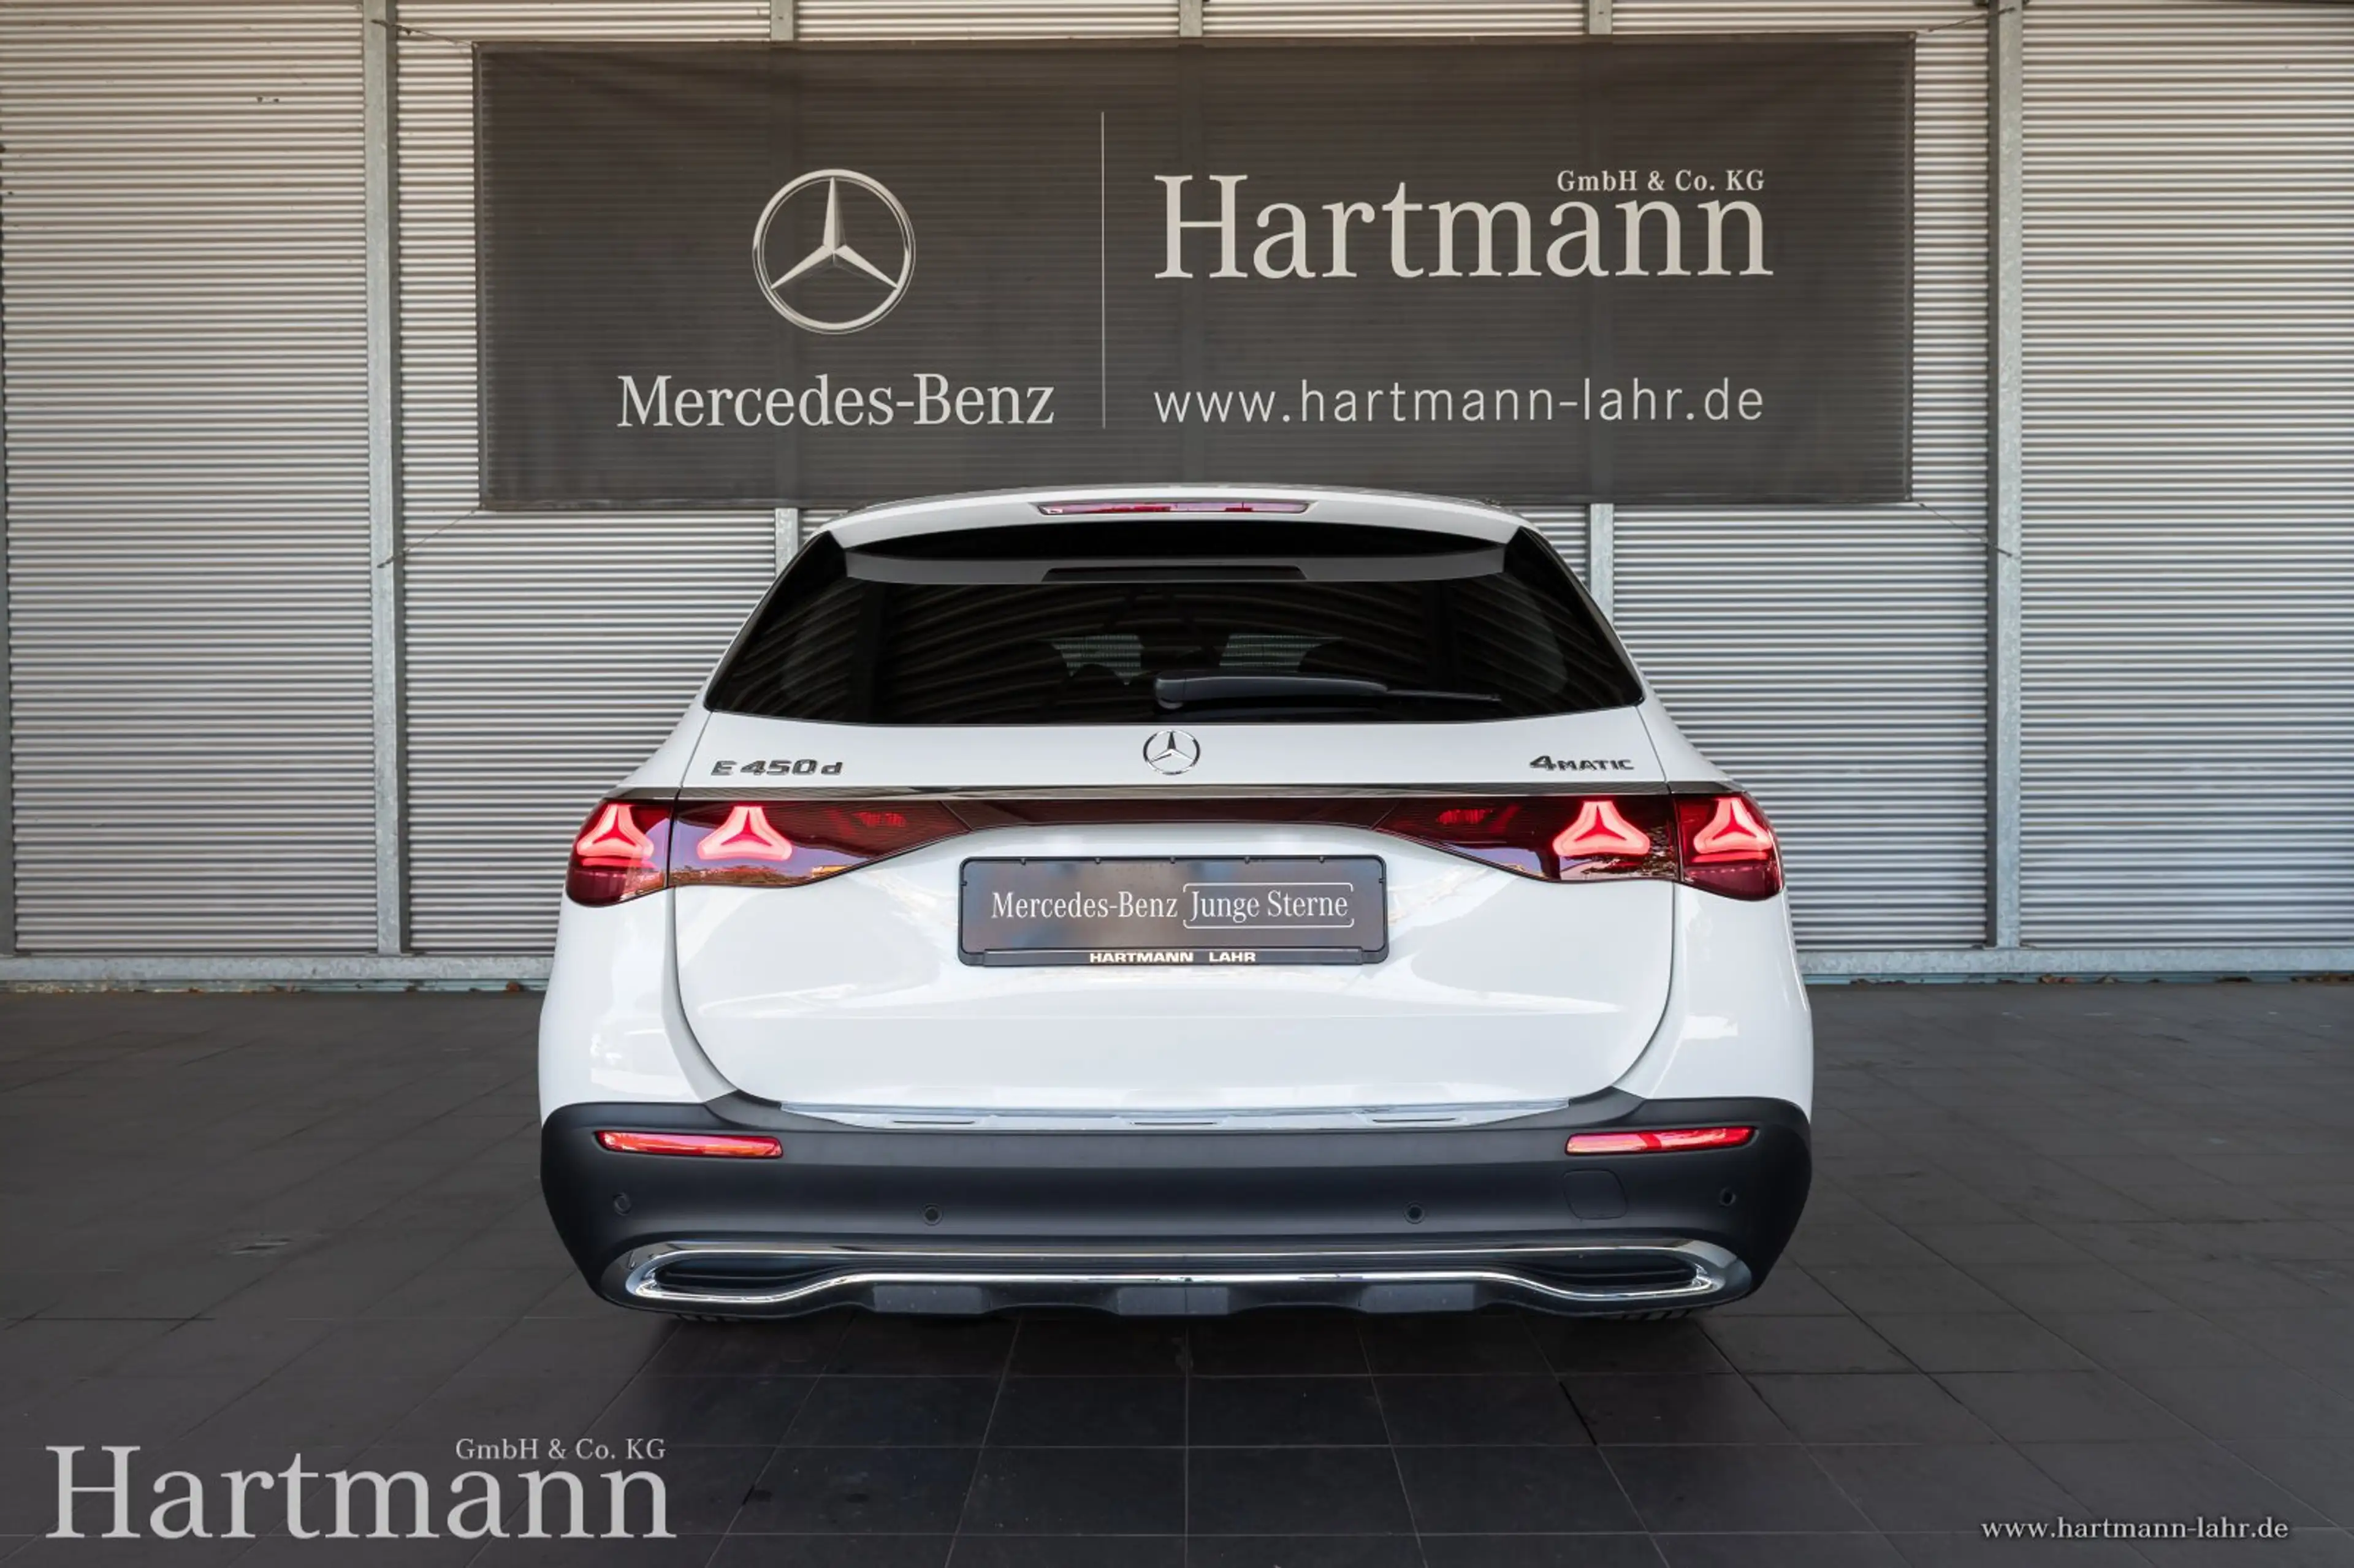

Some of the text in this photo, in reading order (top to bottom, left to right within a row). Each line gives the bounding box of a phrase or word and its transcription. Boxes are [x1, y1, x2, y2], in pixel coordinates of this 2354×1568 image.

[1557, 170, 1764, 191] GmbH & Co. KG
[1154, 174, 1773, 280] Hartmann
[617, 373, 1054, 427] Mercedes-Benz
[1154, 377, 1763, 424] www.hartmann-lahr.de
[711, 758, 843, 776] E 450 d
[1529, 755, 1634, 771] 4MATIC
[991, 889, 1349, 923] Mercedes-Benz Junge Sterne
[1089, 951, 1257, 964] HARTMANN LAHR
